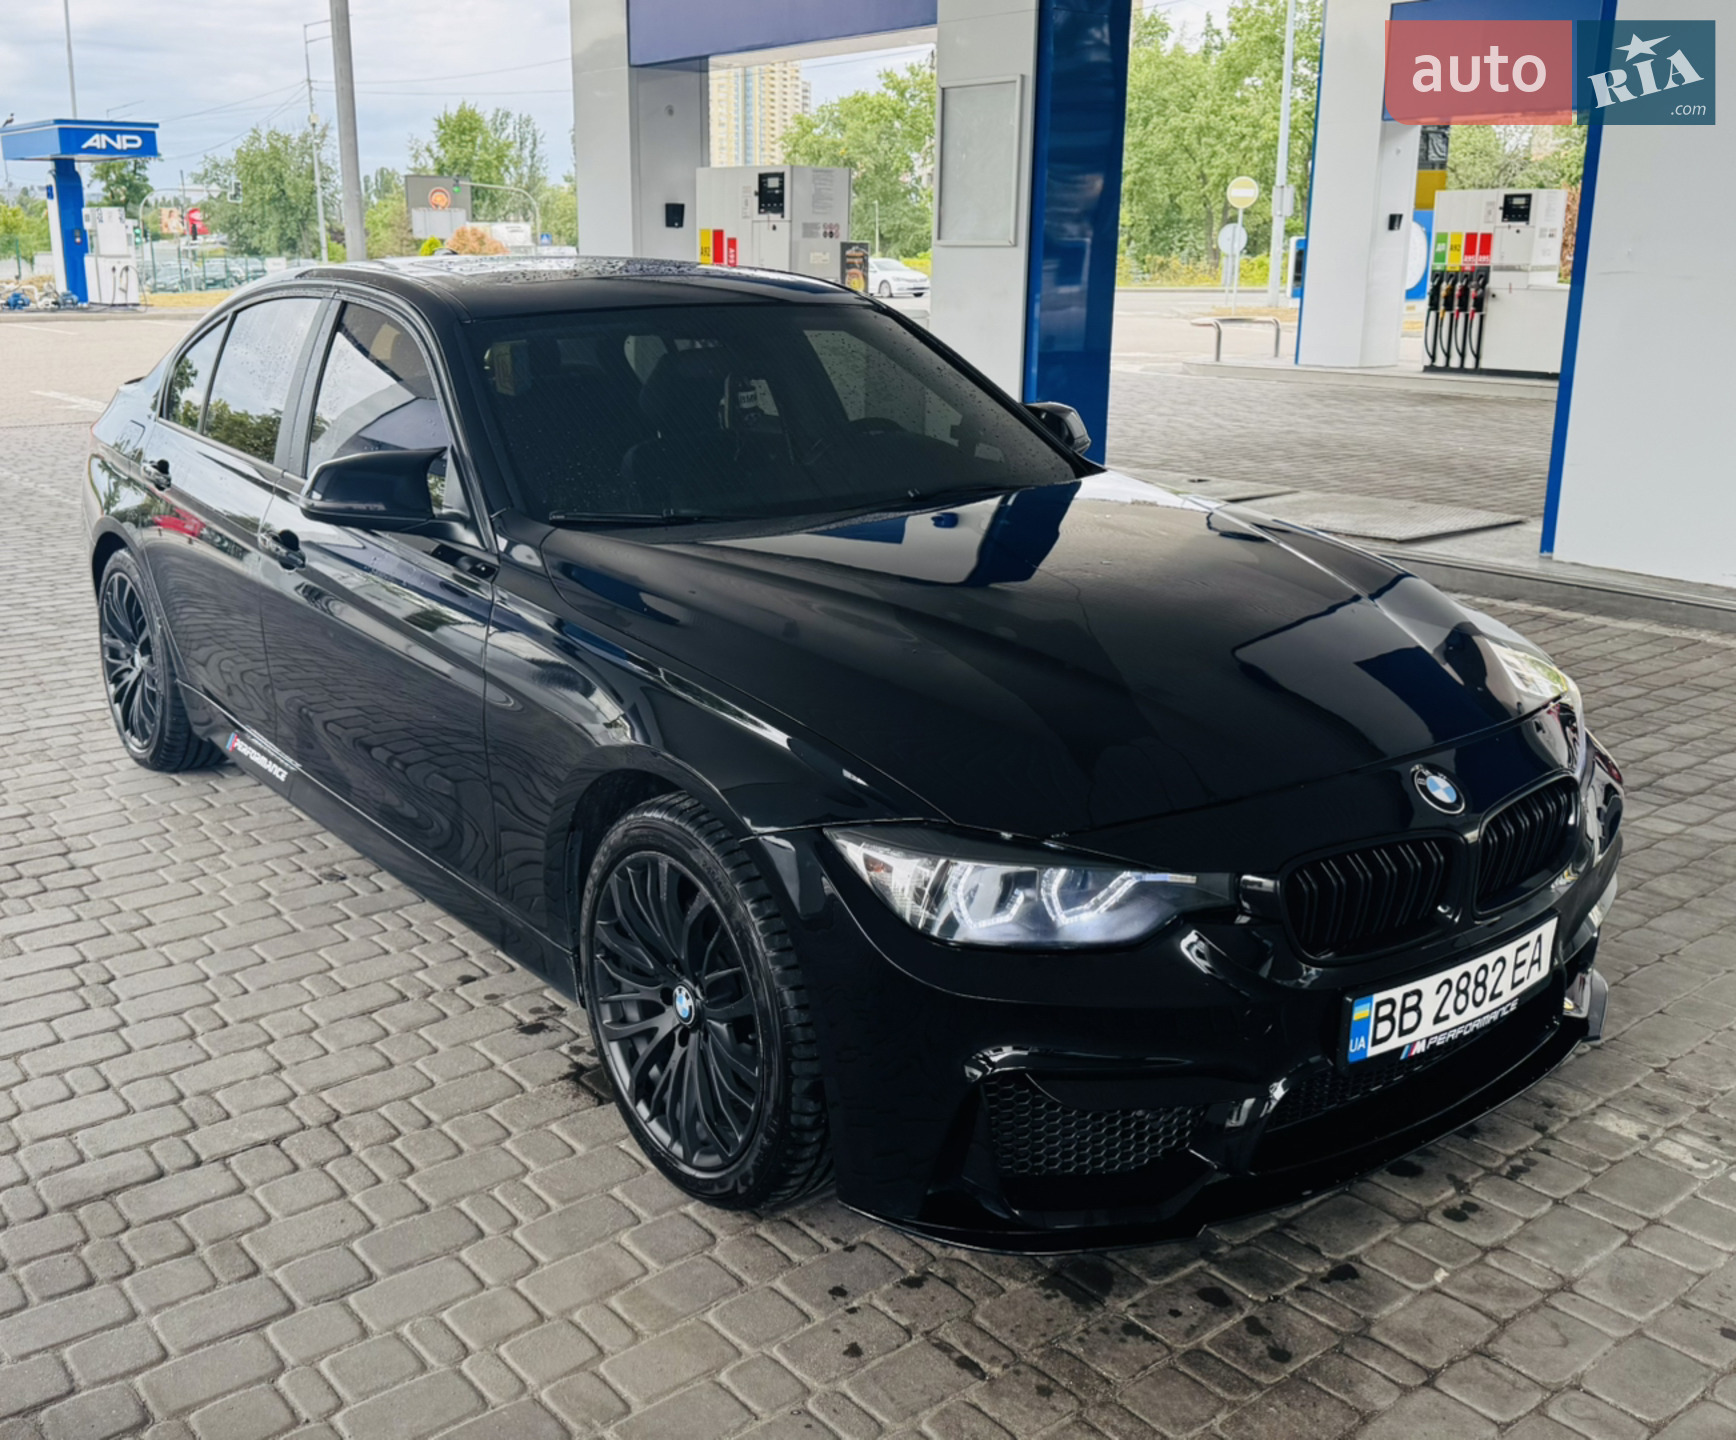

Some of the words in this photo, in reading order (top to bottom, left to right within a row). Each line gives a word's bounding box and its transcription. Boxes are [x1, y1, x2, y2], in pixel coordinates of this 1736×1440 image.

[81, 133, 143, 150] ANP
[1371, 989, 1423, 1048] BB
[1433, 956, 1507, 1026] 2882
[1510, 933, 1543, 991] EA
[1349, 1035, 1367, 1054] UA
